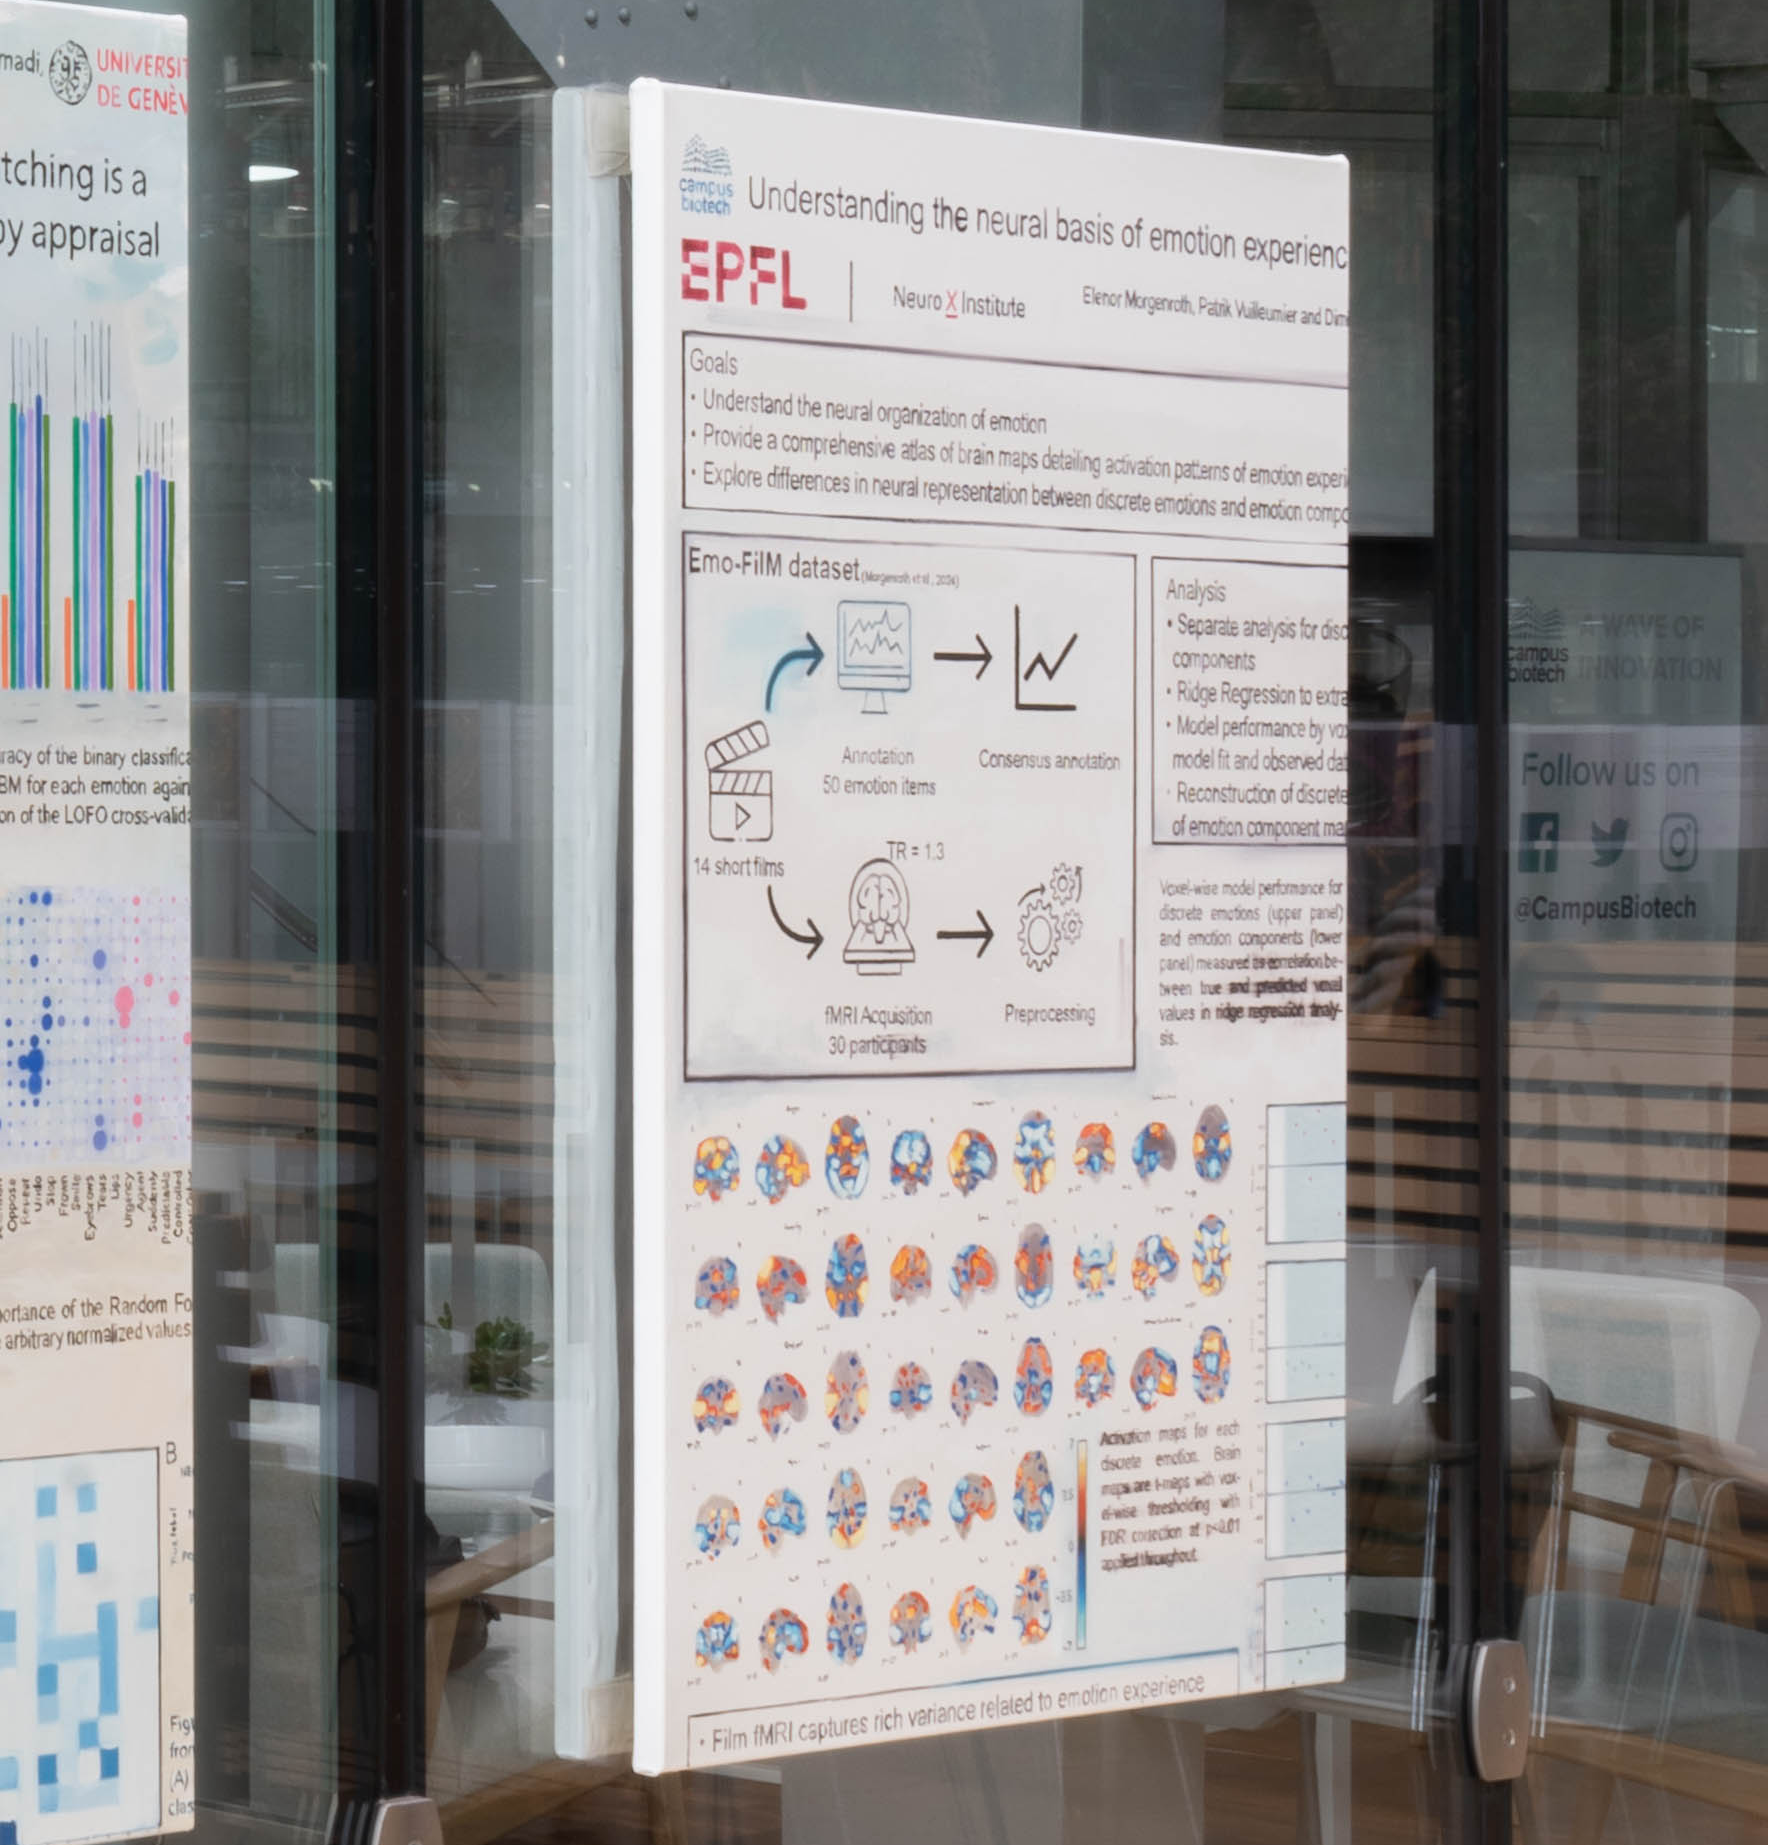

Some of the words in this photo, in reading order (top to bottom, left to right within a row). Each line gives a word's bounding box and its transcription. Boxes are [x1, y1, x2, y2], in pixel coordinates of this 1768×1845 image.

[104, 157, 123, 195] is
[131, 169, 147, 197] a
[748, 175, 924, 235] Understanding
[932, 197, 968, 233] the
[976, 208, 1048, 240] neural
[1056, 208, 1114, 246] basis
[1121, 217, 1144, 249] of
[1149, 224, 1236, 258] emotion
[31, 220, 160, 261] appraisal
[681, 238, 807, 311] EPFL
[893, 285, 943, 311] Neuro
[945, 291, 959, 320] X
[961, 291, 1026, 319] Institute
[690, 348, 738, 375] Goals
[703, 387, 793, 417] Understand
[797, 394, 822, 418] the
[825, 400, 873, 422] neural
[876, 402, 967, 431] organization
[971, 407, 987, 430] of
[989, 414, 1047, 434] emotion
[788, 551, 860, 582] dataset
[841, 745, 915, 766] Annotation
[978, 748, 1052, 770] Consensus
[1054, 752, 1121, 771] annotation
[1523, 751, 1615, 788] Follow
[1625, 764, 1655, 786] us
[1665, 761, 1700, 788] on
[693, 857, 710, 875] 14
[714, 857, 752, 877] short
[753, 855, 785, 877] films
[1517, 894, 1697, 924] @CampusBiotech
[1004, 1003, 1096, 1027] Preprocessing
[712, 1728, 748, 1753] Film
[753, 1720, 793, 1747] fMRI
[798, 1715, 869, 1744] captures
[874, 1707, 903, 1732] rich
[907, 1703, 977, 1728] variance
[980, 1691, 1034, 1719] related
[1037, 1691, 1053, 1712] to
[1057, 1684, 1117, 1709] emotion
[1123, 1677, 1203, 1701] experience
